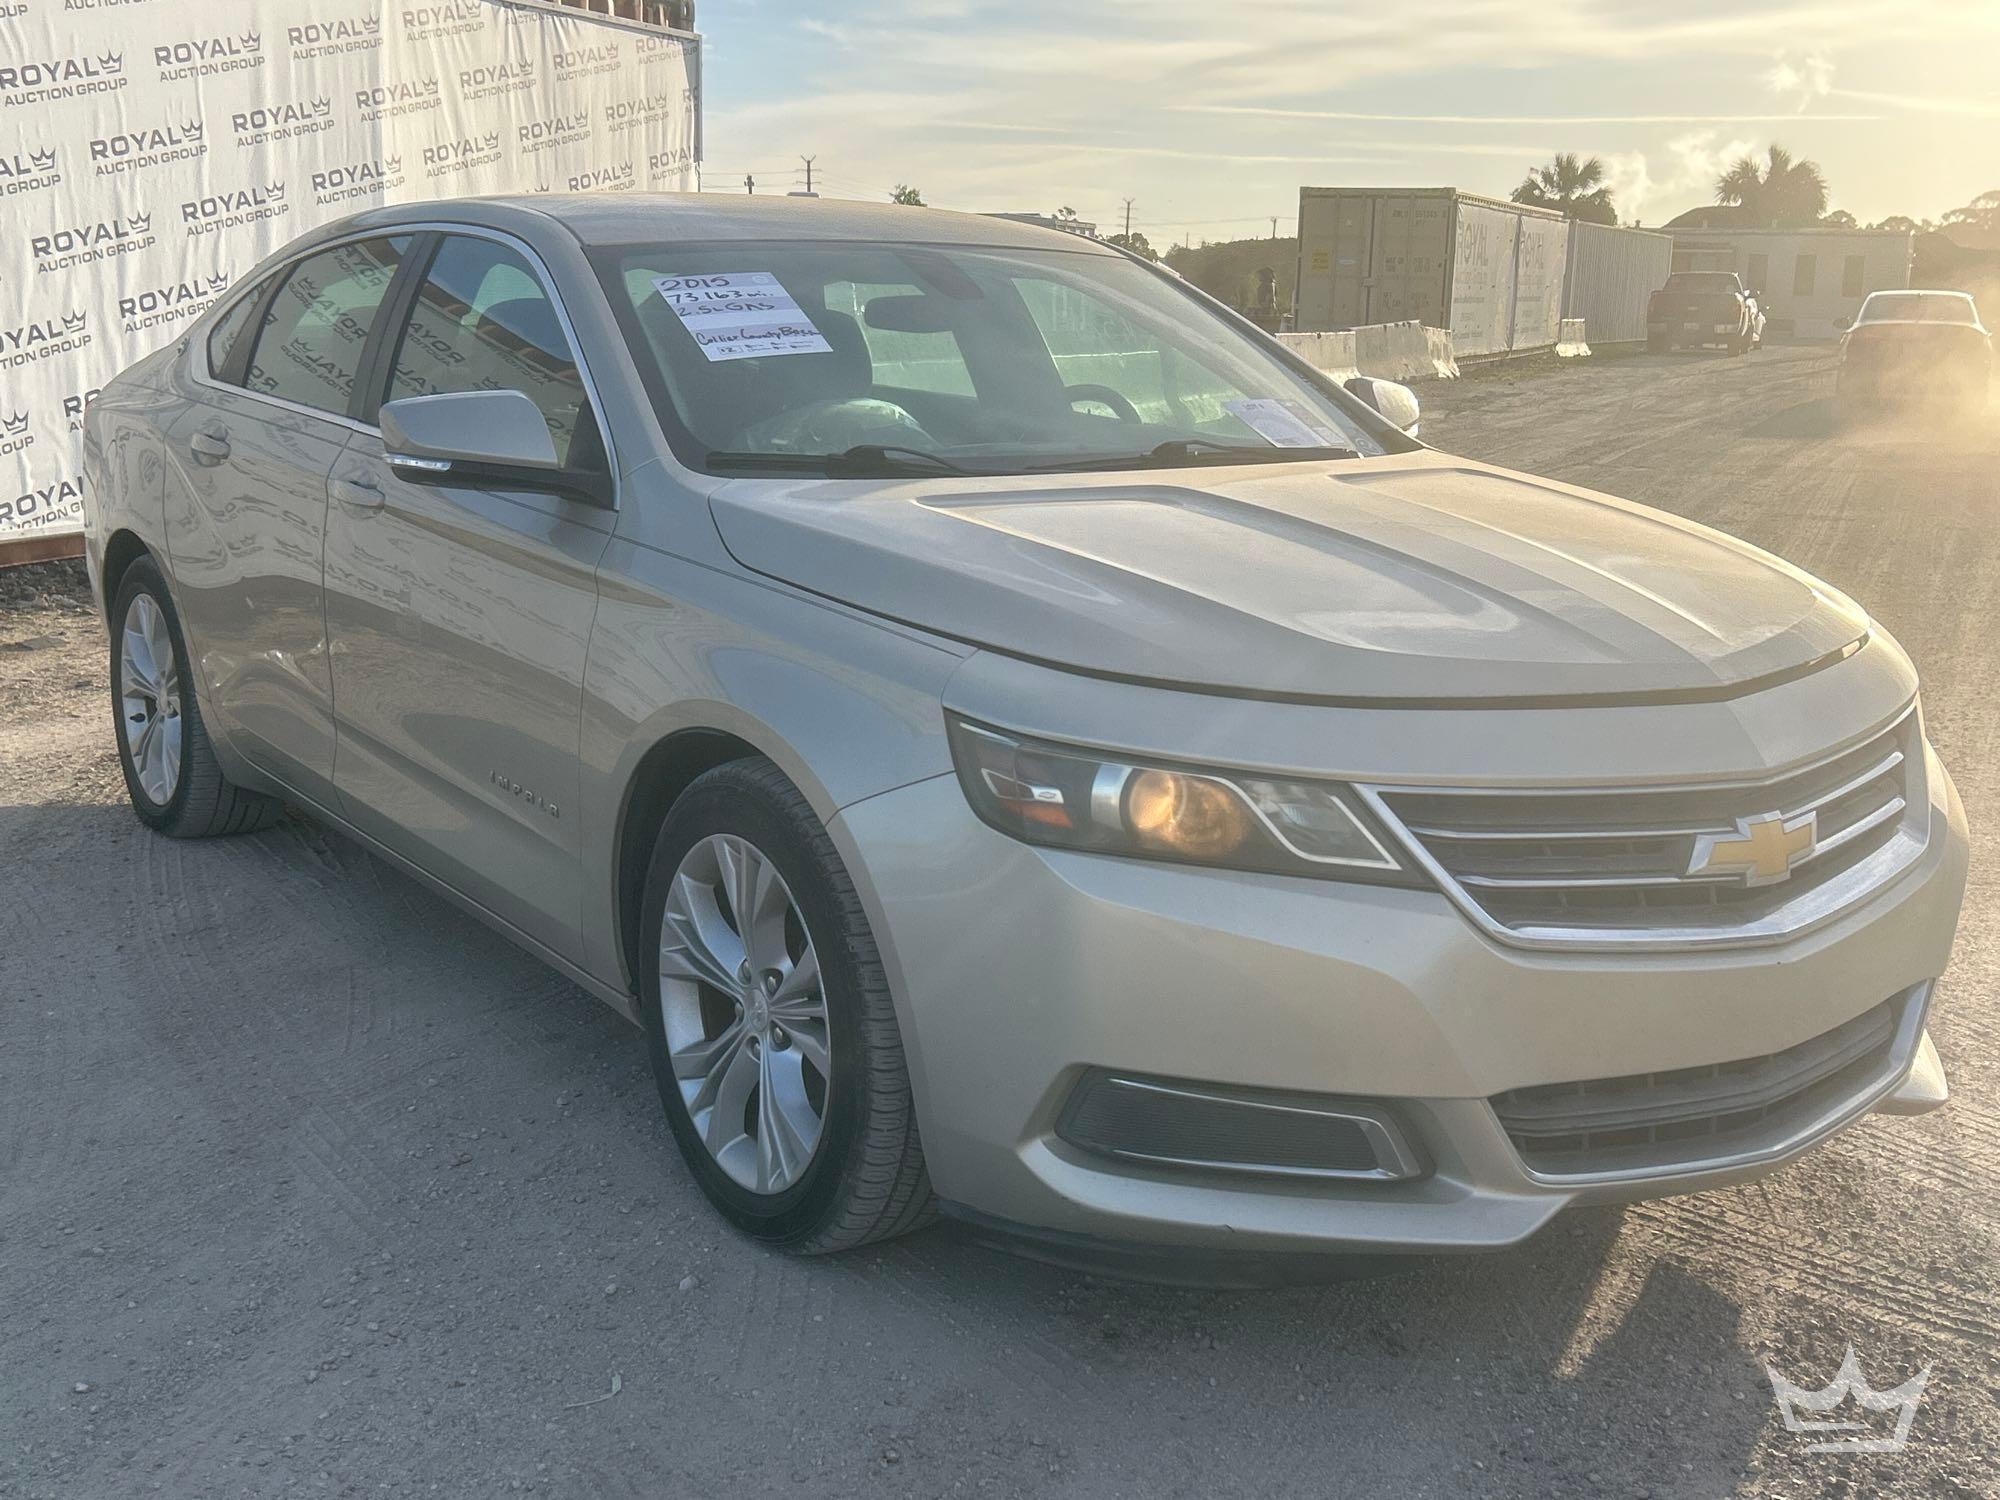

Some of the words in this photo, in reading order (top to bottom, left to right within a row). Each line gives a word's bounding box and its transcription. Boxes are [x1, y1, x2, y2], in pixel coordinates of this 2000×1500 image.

[402, 0, 467, 28] ROYAL
[287, 18, 363, 46] ROYAL
[406, 26, 450, 42] AUCTION
[451, 21, 485, 35] GROUP
[153, 36, 242, 67] ROYAL
[293, 43, 343, 62] AUCTION
[344, 38, 384, 53] GROUP
[552, 46, 606, 71] ROYAL
[0, 57, 100, 90] ROYAL
[159, 62, 219, 82] AUCTION
[220, 56, 265, 73] GROUP
[459, 62, 520, 89] ROYAL
[556, 66, 593, 82] AUCTION
[594, 61, 622, 76] GROUP
[4, 85, 74, 107] AUCTION
[76, 77, 128, 96] GROUP
[355, 81, 424, 109] ROYAL
[463, 86, 504, 102] AUCTION
[505, 78, 537, 93] GROUP
[232, 102, 313, 133] ROYAL
[360, 105, 407, 123] AUCTION
[408, 97, 442, 113] GROUP
[605, 97, 656, 121] ROYAL
[608, 117, 642, 133] AUCTION
[643, 110, 670, 125] GROUP
[90, 126, 183, 161] ROYAL
[237, 127, 292, 148] AUCTION
[293, 119, 335, 136] GROUP
[518, 116, 576, 143] ROYAL
[521, 137, 561, 155] AUCTION
[561, 130, 591, 145] GROUP
[95, 155, 159, 177] AUCTION
[160, 144, 208, 163] GROUP
[423, 137, 485, 165] ROYAL
[426, 161, 469, 178] AUCTION
[469, 151, 502, 168] GROUP
[7, 174, 61, 195] GROUP
[311, 161, 386, 192] ROYAL
[316, 187, 368, 206] AUCTION
[369, 175, 405, 193] GROUP
[568, 166, 621, 192] ROYAL
[181, 188, 266, 222] ROYAL
[186, 215, 244, 238] AUCTION
[245, 203, 289, 222] GROUP
[32, 220, 130, 258] ROYAL
[38, 250, 104, 274] AUCTION
[106, 236, 156, 257] GROUP
[660, 275, 730, 292] 2015
[119, 280, 209, 318] ROYAL
[125, 308, 186, 334] AUCTION
[40, 334, 92, 358] GROUP
[489, 769, 560, 818] IMPALA
